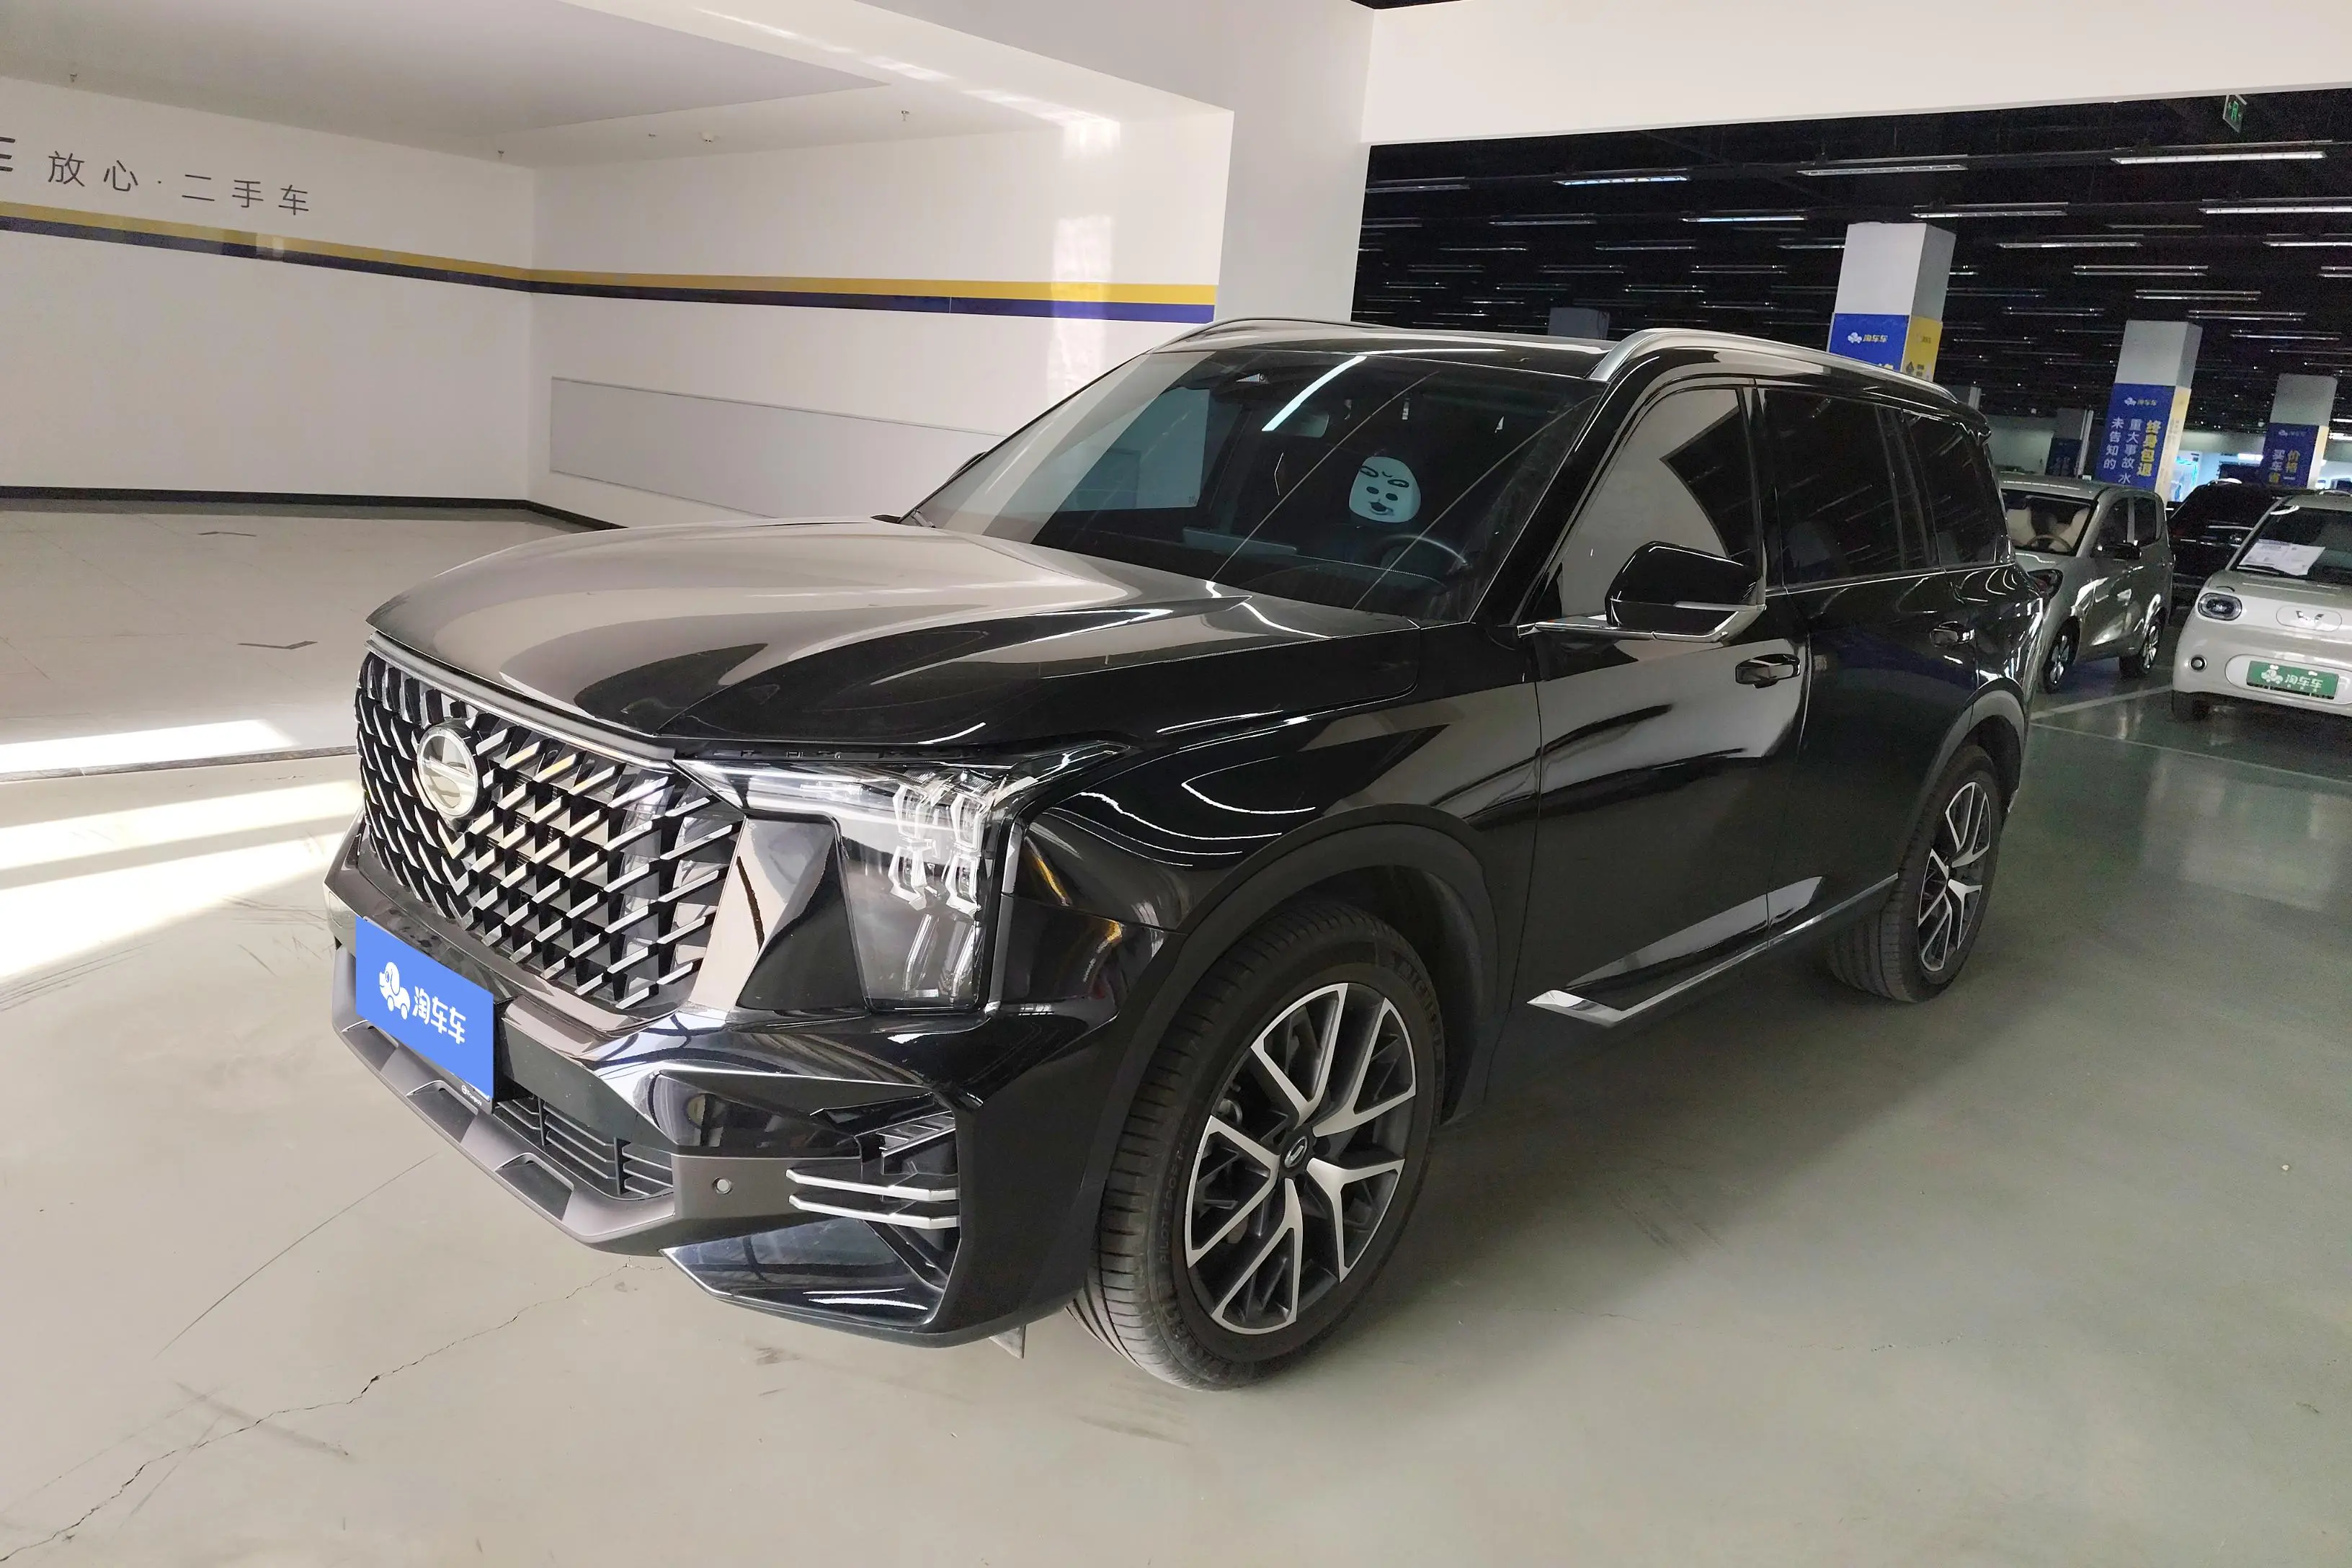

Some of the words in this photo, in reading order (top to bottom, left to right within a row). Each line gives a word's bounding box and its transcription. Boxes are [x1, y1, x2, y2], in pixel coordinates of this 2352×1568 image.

[2103, 416, 2125, 470] 未告知的
[2137, 419, 2162, 476] 终身包退
[2284, 674, 2323, 688] 淘车车
